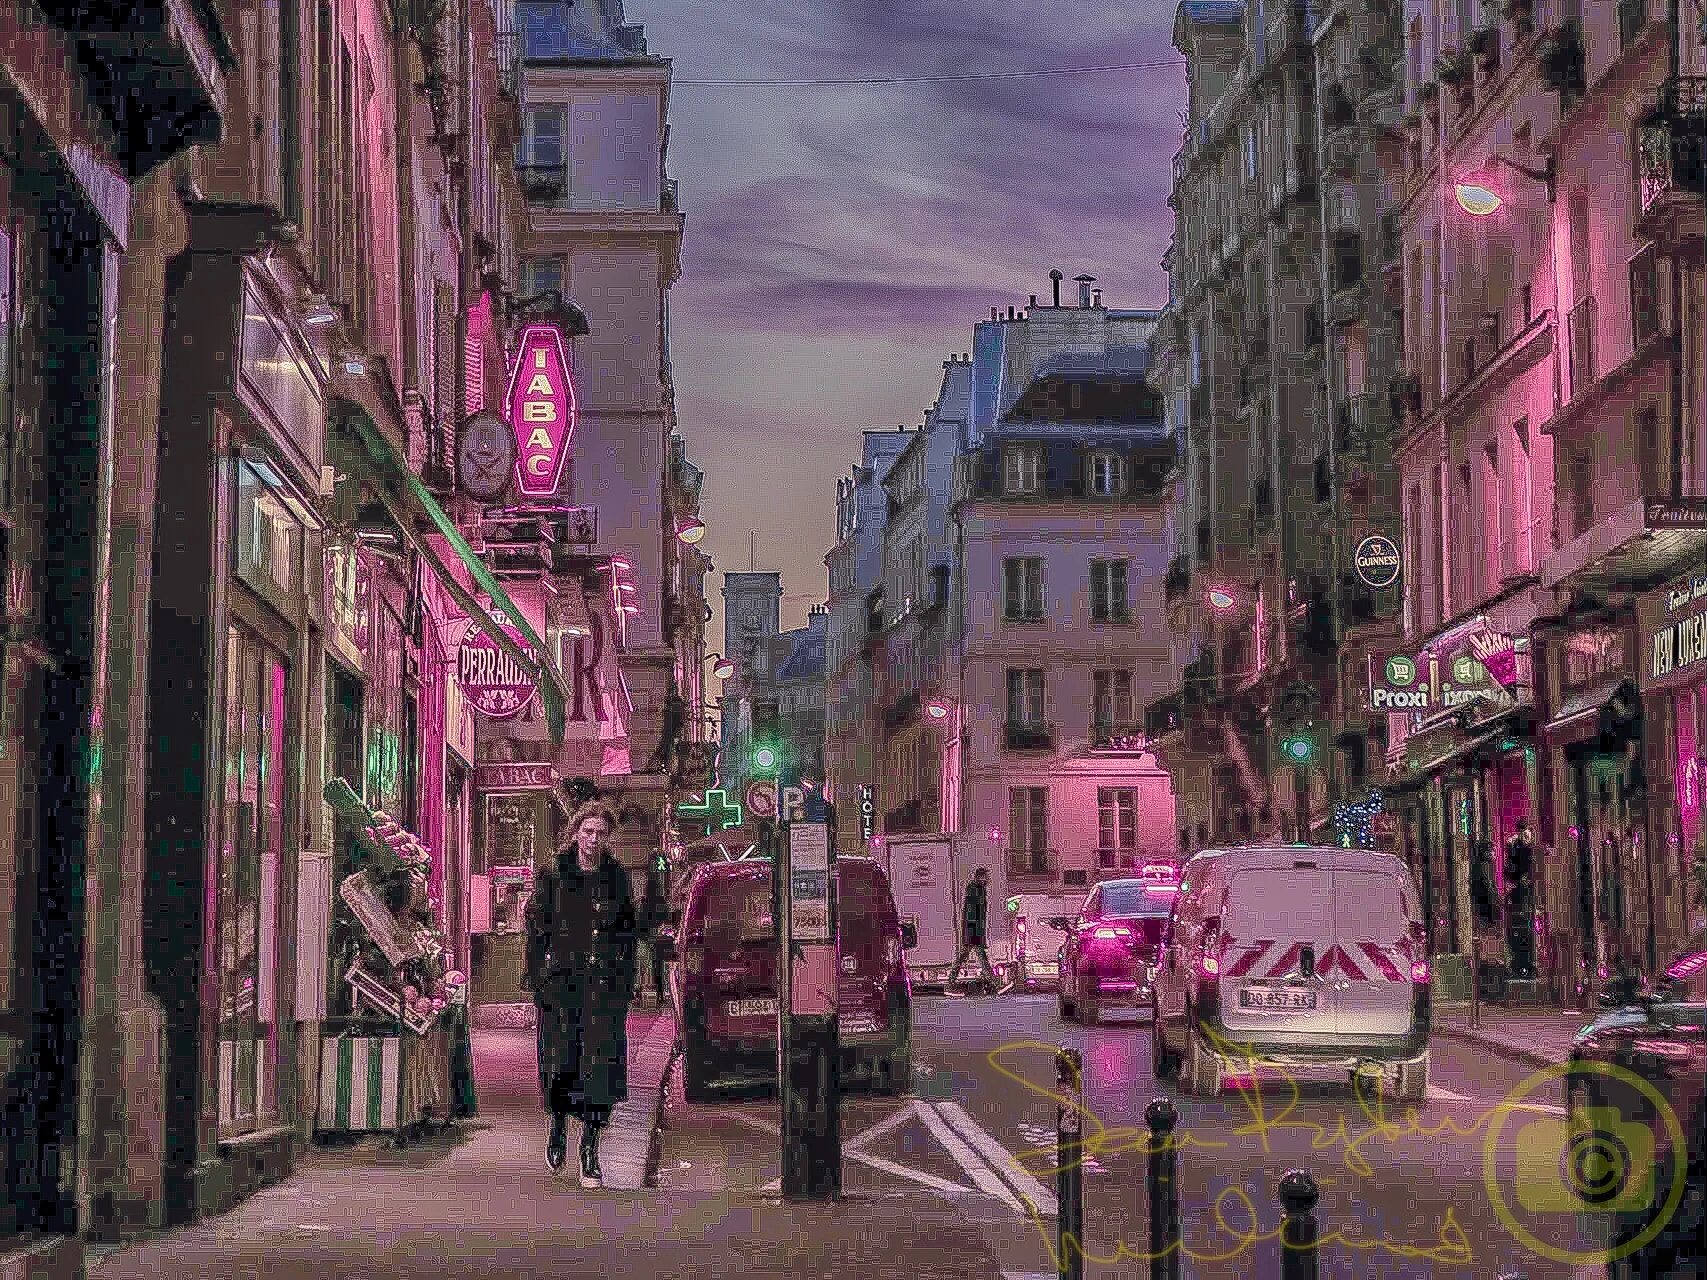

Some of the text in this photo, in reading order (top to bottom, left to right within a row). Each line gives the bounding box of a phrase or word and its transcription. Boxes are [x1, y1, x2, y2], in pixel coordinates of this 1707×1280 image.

[523, 347, 557, 476] TABAC
[1357, 555, 1398, 567] GUINNESS
[1373, 682, 1428, 707] Proxi
